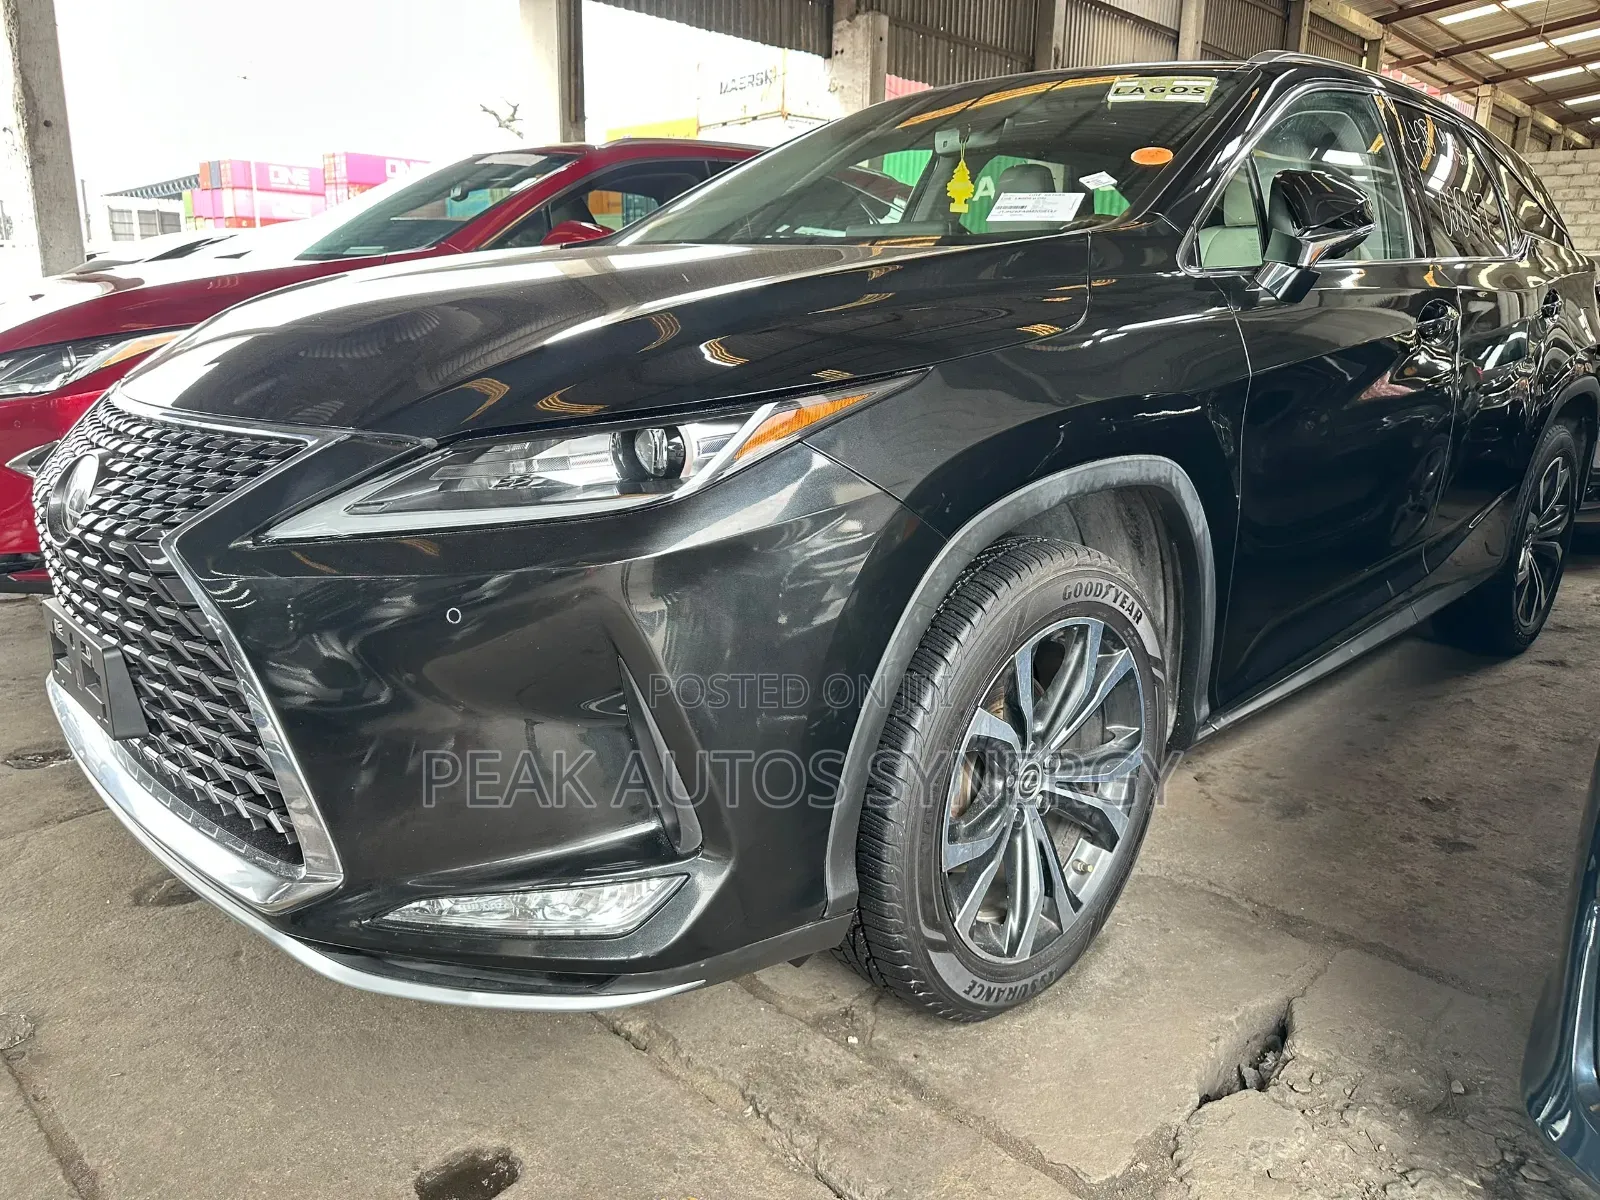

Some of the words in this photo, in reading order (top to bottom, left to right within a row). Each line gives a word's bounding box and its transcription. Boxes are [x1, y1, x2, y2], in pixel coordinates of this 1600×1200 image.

[719, 68, 773, 95] MAERSK
[1113, 86, 1206, 95] LAGOS
[269, 165, 311, 186] ONE
[1062, 581, 1142, 625] GOODYEAR
[962, 968, 1057, 1003] ASSURANCE
